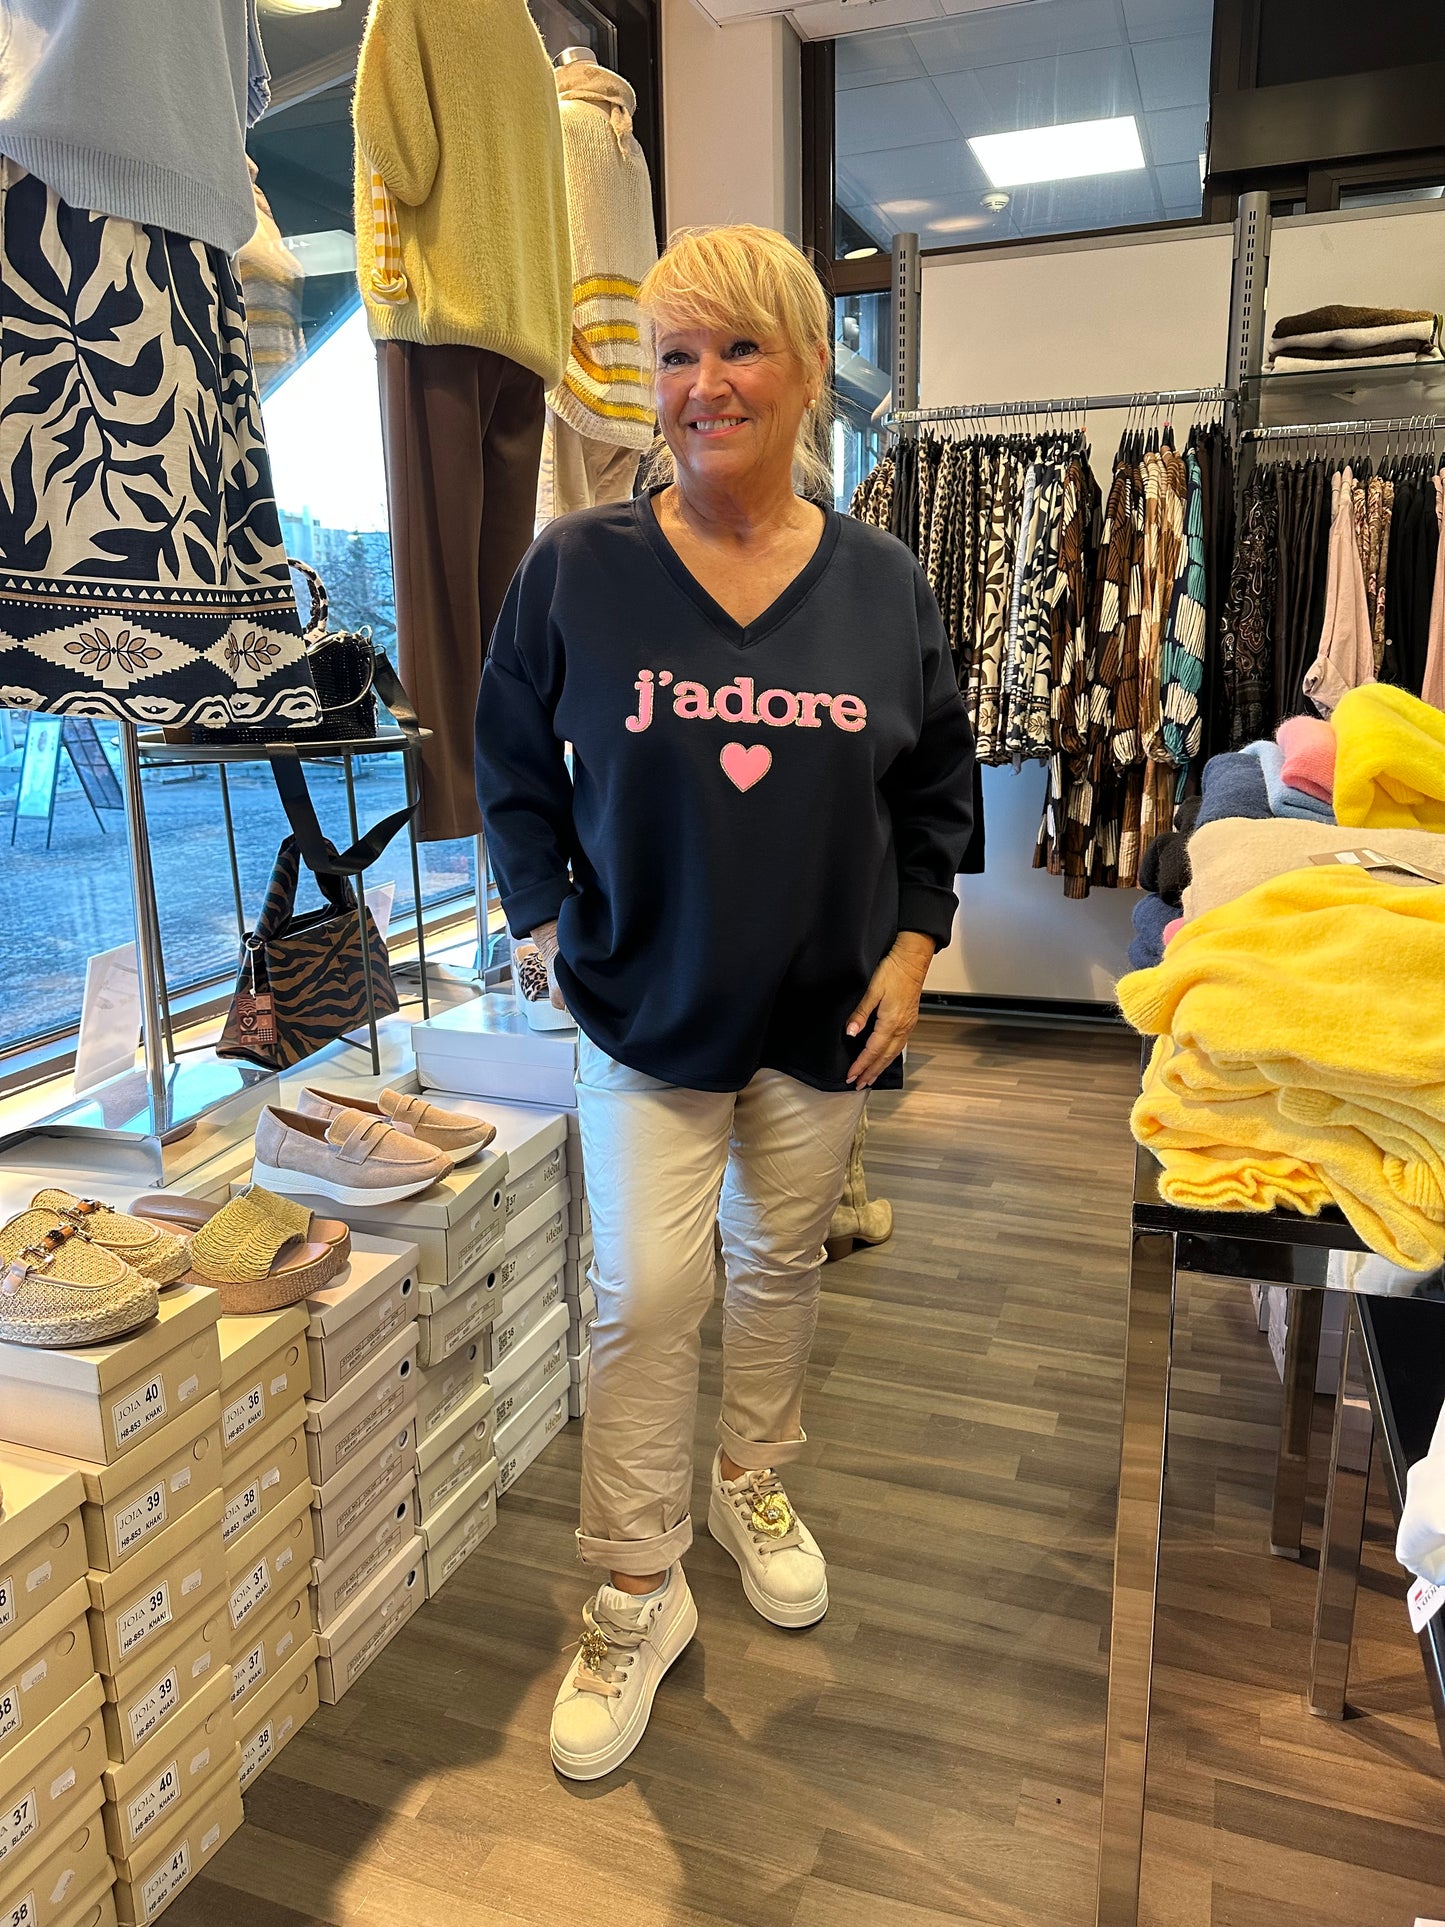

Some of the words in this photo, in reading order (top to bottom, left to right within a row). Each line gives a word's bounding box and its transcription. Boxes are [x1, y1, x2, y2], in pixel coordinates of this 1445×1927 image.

[625, 669, 867, 732] j'adore
[118, 1400, 141, 1421] JOIA
[145, 1383, 159, 1402] 40
[226, 1405, 245, 1424] JOIA
[248, 1390, 260, 1409] 36
[145, 1405, 163, 1422] KHAKI
[247, 1410, 262, 1425] KHAKI
[243, 1489, 254, 1507] 38
[120, 1508, 143, 1530] JOIA
[146, 1491, 160, 1512] 39
[145, 1512, 163, 1530] KHAKI
[242, 1507, 257, 1523] KHAKI
[233, 1585, 251, 1608] JOIA
[253, 1566, 263, 1585] 37
[255, 1582, 269, 1600] KHAKI
[122, 1609, 146, 1632] JOIA
[149, 1591, 163, 1612] 39
[148, 1611, 167, 1630] KHAKI
[248, 1650, 259, 1670] 37
[134, 1698, 156, 1724] JOIA
[159, 1678, 172, 1699] 39
[159, 1696, 175, 1716] KHAKI
[258, 1729, 269, 1748] 38
[133, 1793, 156, 1818] JOIA
[159, 1772, 172, 1792] 40
[159, 1789, 176, 1810] KHAKI
[13, 1800, 28, 1826] 37
[11, 1821, 33, 1846] BLACK
[147, 1872, 168, 1898] JOIA
[172, 1850, 183, 1871] 41
[171, 1867, 187, 1888] KHAKI
[11, 1903, 28, 1927] 38
